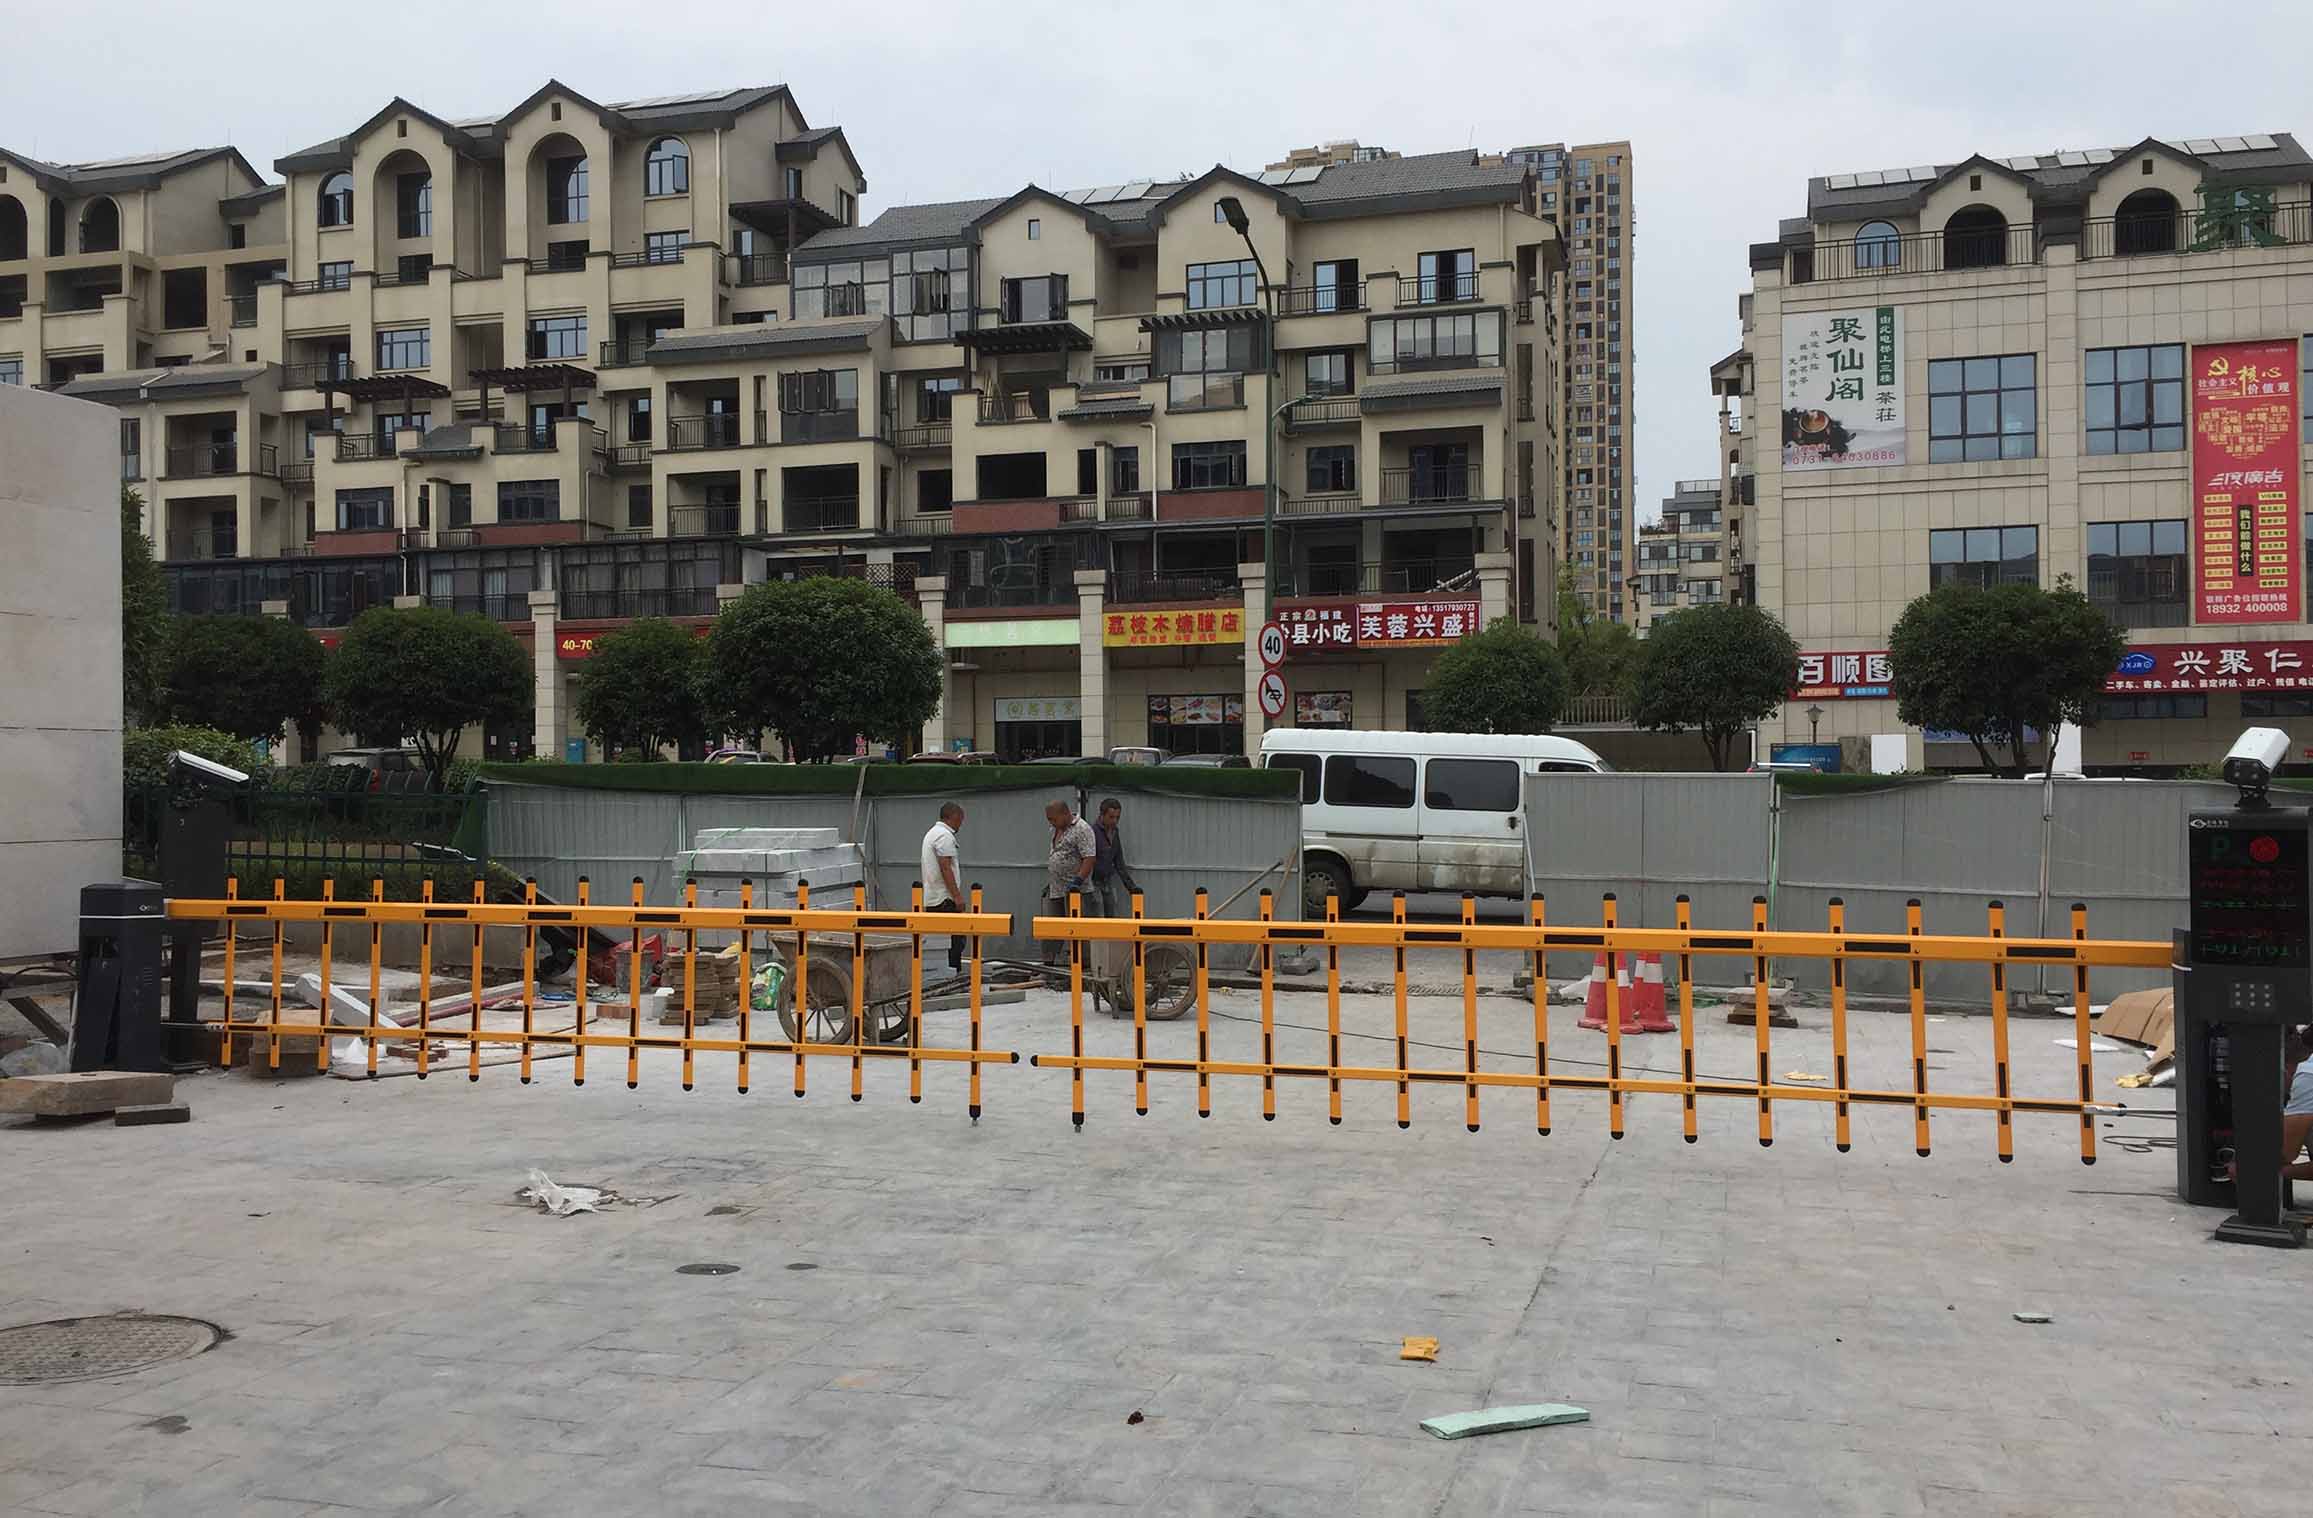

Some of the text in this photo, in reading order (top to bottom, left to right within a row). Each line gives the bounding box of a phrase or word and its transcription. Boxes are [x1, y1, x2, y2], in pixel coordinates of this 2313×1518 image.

[1825, 317, 1867, 402] 聚仙阁
[2247, 382, 2290, 395] 价值观
[2239, 509, 2252, 573] 我们能做什么
[1280, 610, 1343, 621] 正宗 福建
[2206, 602, 2288, 614] 18932 400008
[1360, 613, 1464, 639] 芙蓉兴盛
[562, 639, 593, 650] 40-70
[1265, 635, 1281, 655] 40
[1797, 654, 1894, 685] 百顺图
[2173, 648, 2303, 676] 兴聚仁
